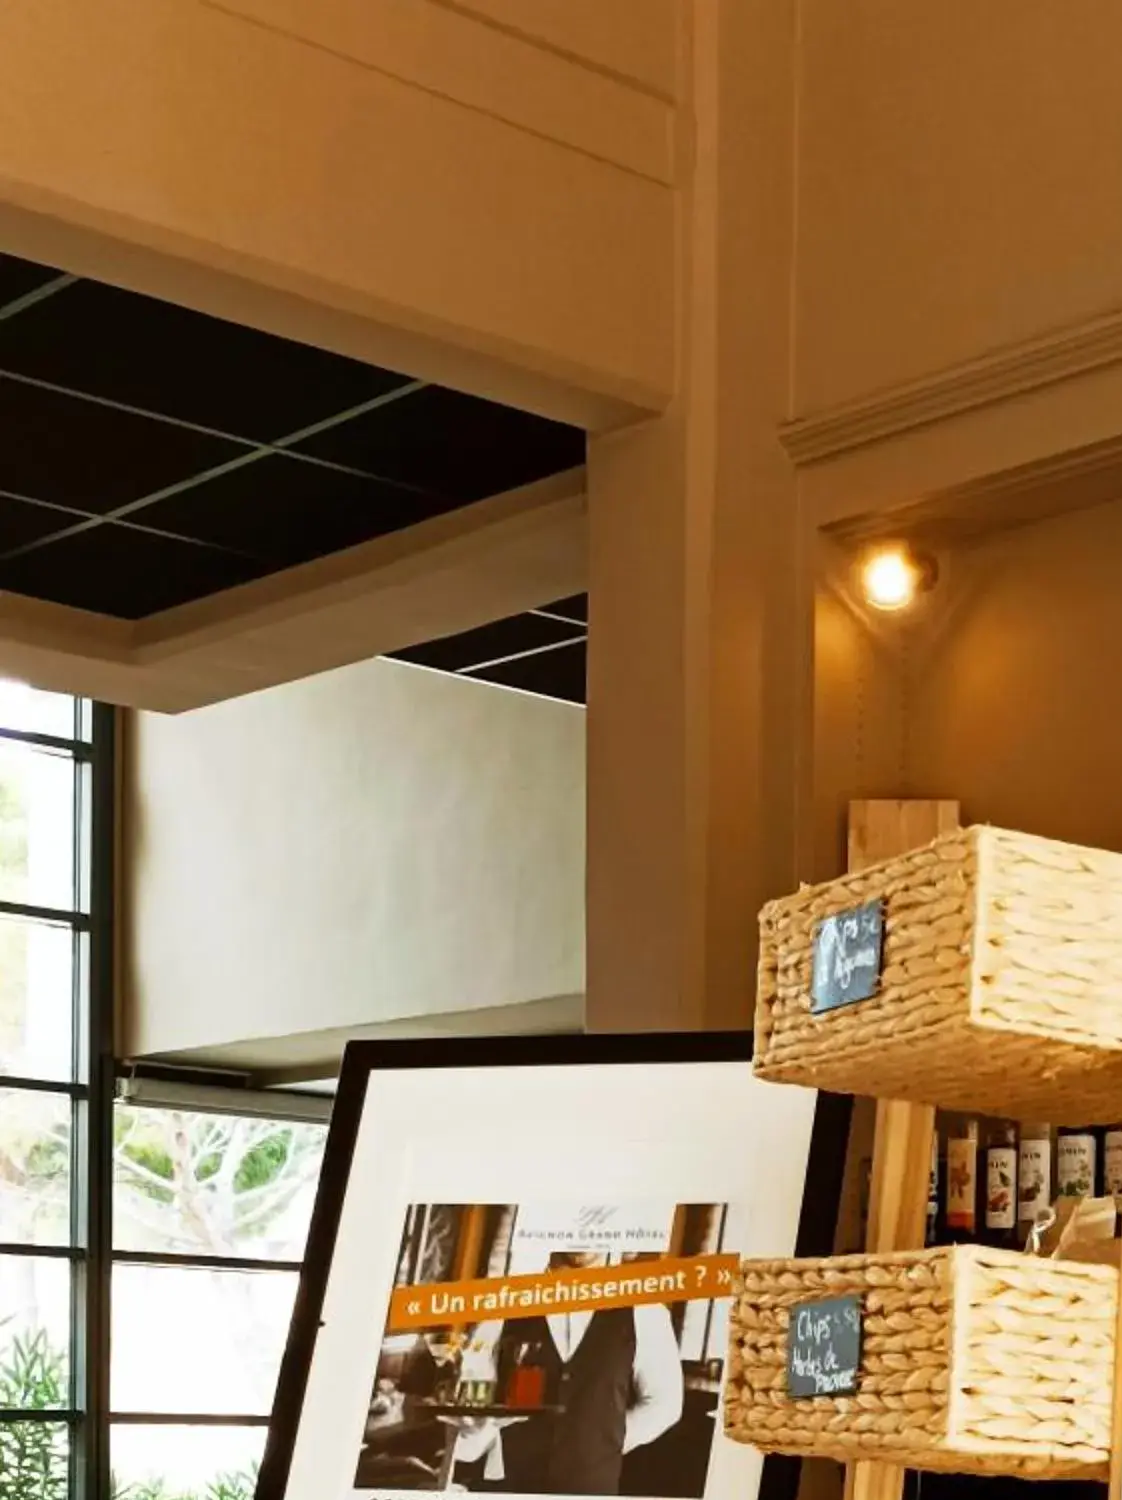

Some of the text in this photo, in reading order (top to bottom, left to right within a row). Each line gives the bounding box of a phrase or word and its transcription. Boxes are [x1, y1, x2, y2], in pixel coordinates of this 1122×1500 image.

[431, 1294, 465, 1315] Un
[473, 1271, 686, 1313] rafraichissement
[695, 1266, 707, 1287] ?
